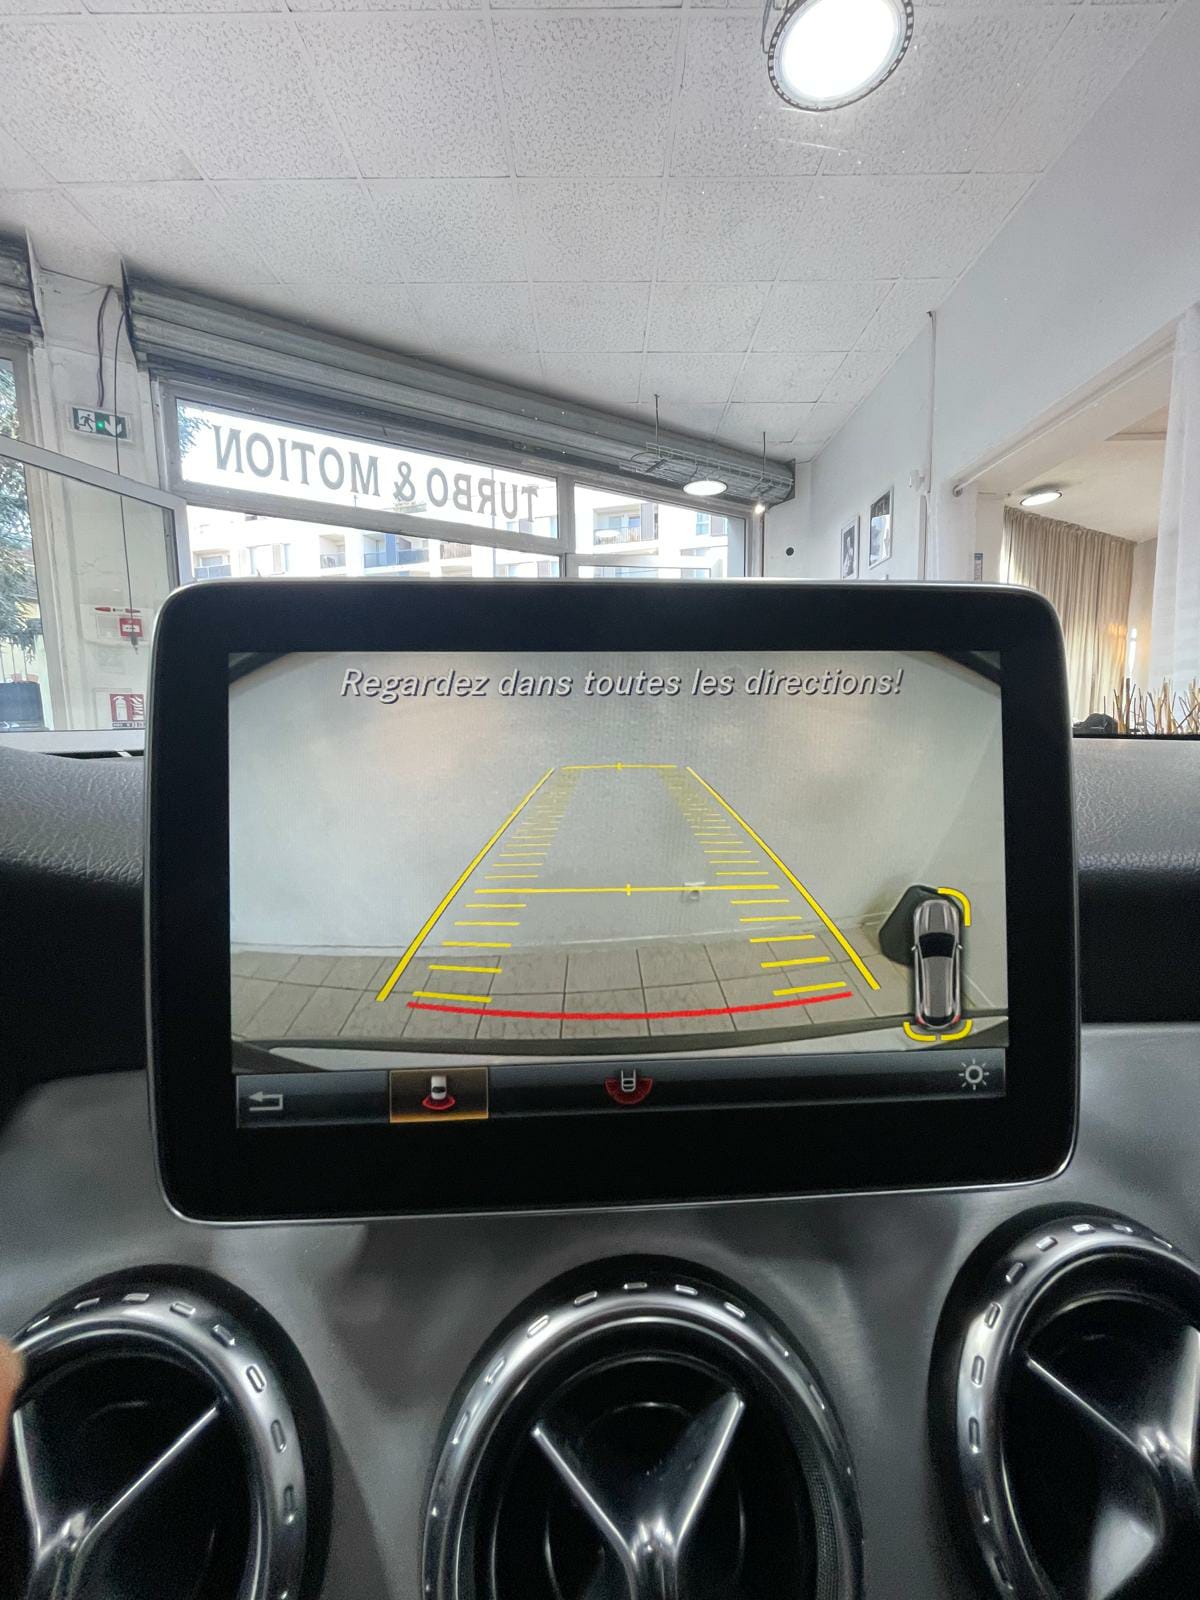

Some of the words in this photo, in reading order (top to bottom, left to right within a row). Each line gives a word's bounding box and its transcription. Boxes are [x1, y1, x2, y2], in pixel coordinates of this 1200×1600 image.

[341, 668, 489, 704] Regardez
[498, 668, 573, 698] dans
[584, 669, 682, 697] toutes
[691, 667, 735, 696] les
[745, 667, 904, 695] directions!
